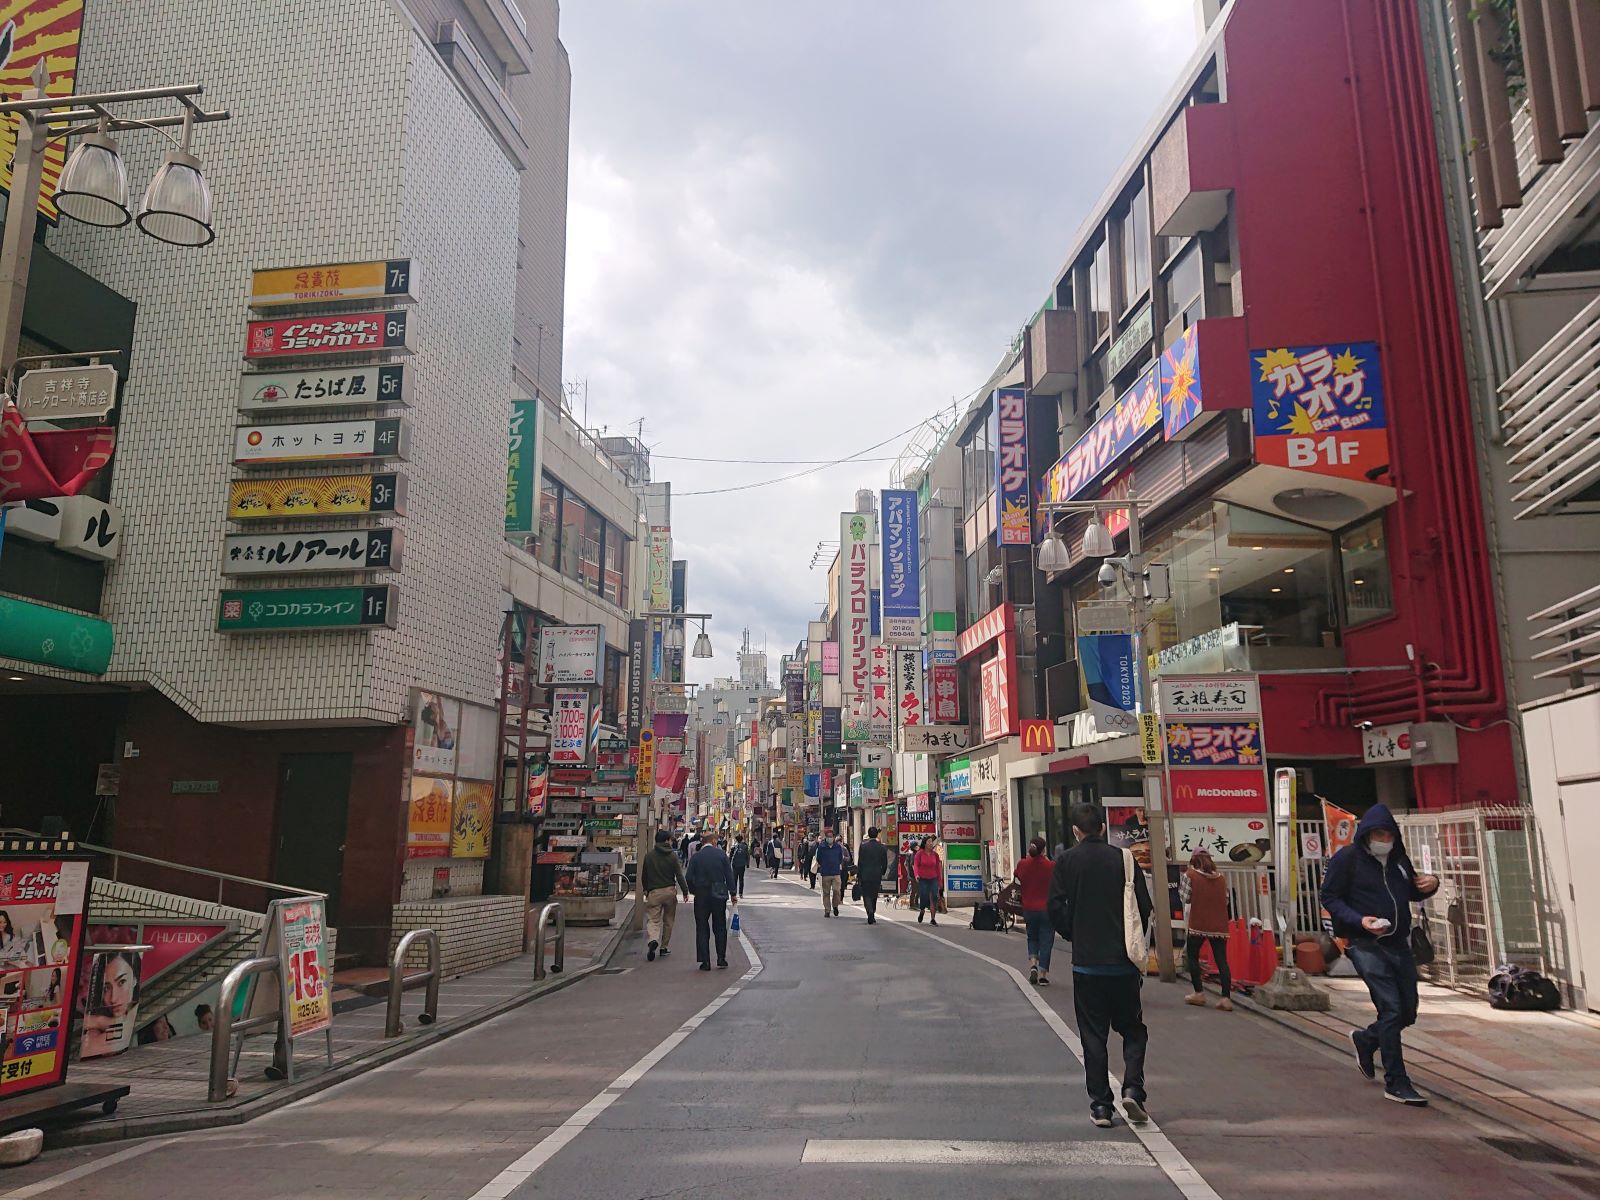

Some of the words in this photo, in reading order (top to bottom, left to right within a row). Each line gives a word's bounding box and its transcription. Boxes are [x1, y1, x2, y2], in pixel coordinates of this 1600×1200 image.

[390, 269, 406, 288] 7F
[294, 290, 339, 299] TORIKIZOKU
[281, 320, 378, 337] インターネット&
[386, 322, 404, 337] 6F
[281, 332, 378, 349] コミックカフェ
[44, 377, 91, 393] 吉祥寺
[294, 375, 366, 399] たらば屋
[381, 375, 399, 393] 5F
[1267, 346, 1367, 418] カラオケ
[1311, 414, 1340, 432] Ban
[1340, 412, 1370, 430] Ban
[271, 429, 367, 447] ホットヨガ
[377, 430, 395, 443] 4F
[1000, 395, 1026, 492] カラオケ
[1056, 418, 1114, 502] カラオケ
[1286, 435, 1360, 467] B1F
[374, 484, 392, 504] 3F
[1004, 529, 1029, 542] B1F
[370, 539, 388, 558] 2F
[888, 496, 906, 598] アパマンショップ
[224, 600, 242, 619] 薬
[266, 601, 355, 616] ココカラファイン
[367, 597, 383, 616] 1F
[632, 641, 642, 693] EXCELSIOR
[902, 652, 916, 691] 横浜家系
[1171, 689, 1247, 706] 元祖寿司
[560, 709, 585, 724] 1700円
[631, 697, 640, 728] CAFFÉ
[559, 724, 584, 739] 1000円
[922, 730, 968, 748] ねぎし
[1170, 725, 1257, 748] カラオケ
[554, 739, 582, 748] ことぶき
[1367, 737, 1396, 758] えん寺
[563, 752, 574, 760] 3F
[1192, 745, 1217, 760] Ban
[1211, 748, 1236, 763] Ban
[1196, 788, 1258, 797] McDonald's
[909, 824, 928, 832] B1F
[1189, 825, 1216, 835] つけ麺
[948, 863, 981, 871] FamilyMart
[147, 930, 207, 944] SHISEIDO
[35, 1034, 51, 1042] FREE
